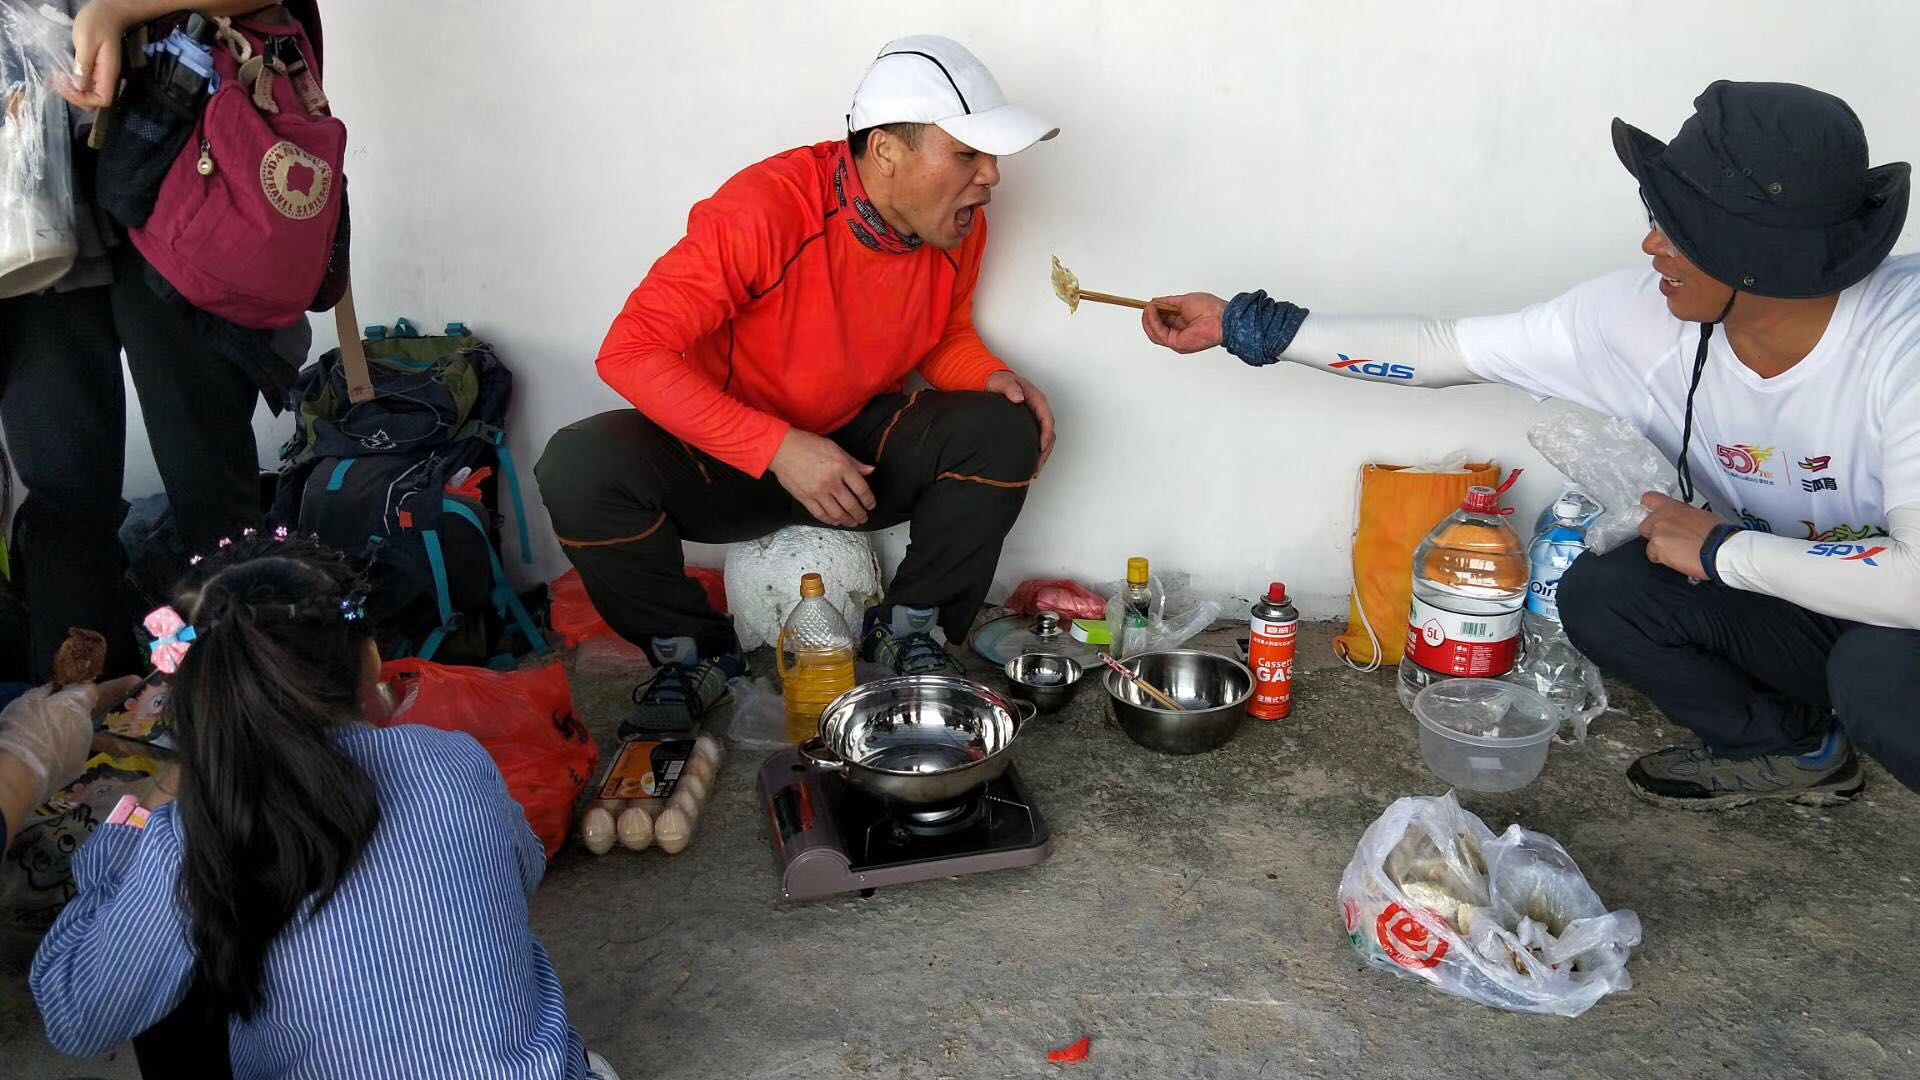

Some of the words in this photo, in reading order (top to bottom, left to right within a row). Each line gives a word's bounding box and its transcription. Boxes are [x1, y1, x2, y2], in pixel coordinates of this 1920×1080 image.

[266, 176, 293, 212] TRAVEL
[1427, 626, 1439, 640] 5L
[1257, 667, 1293, 683] GAS
